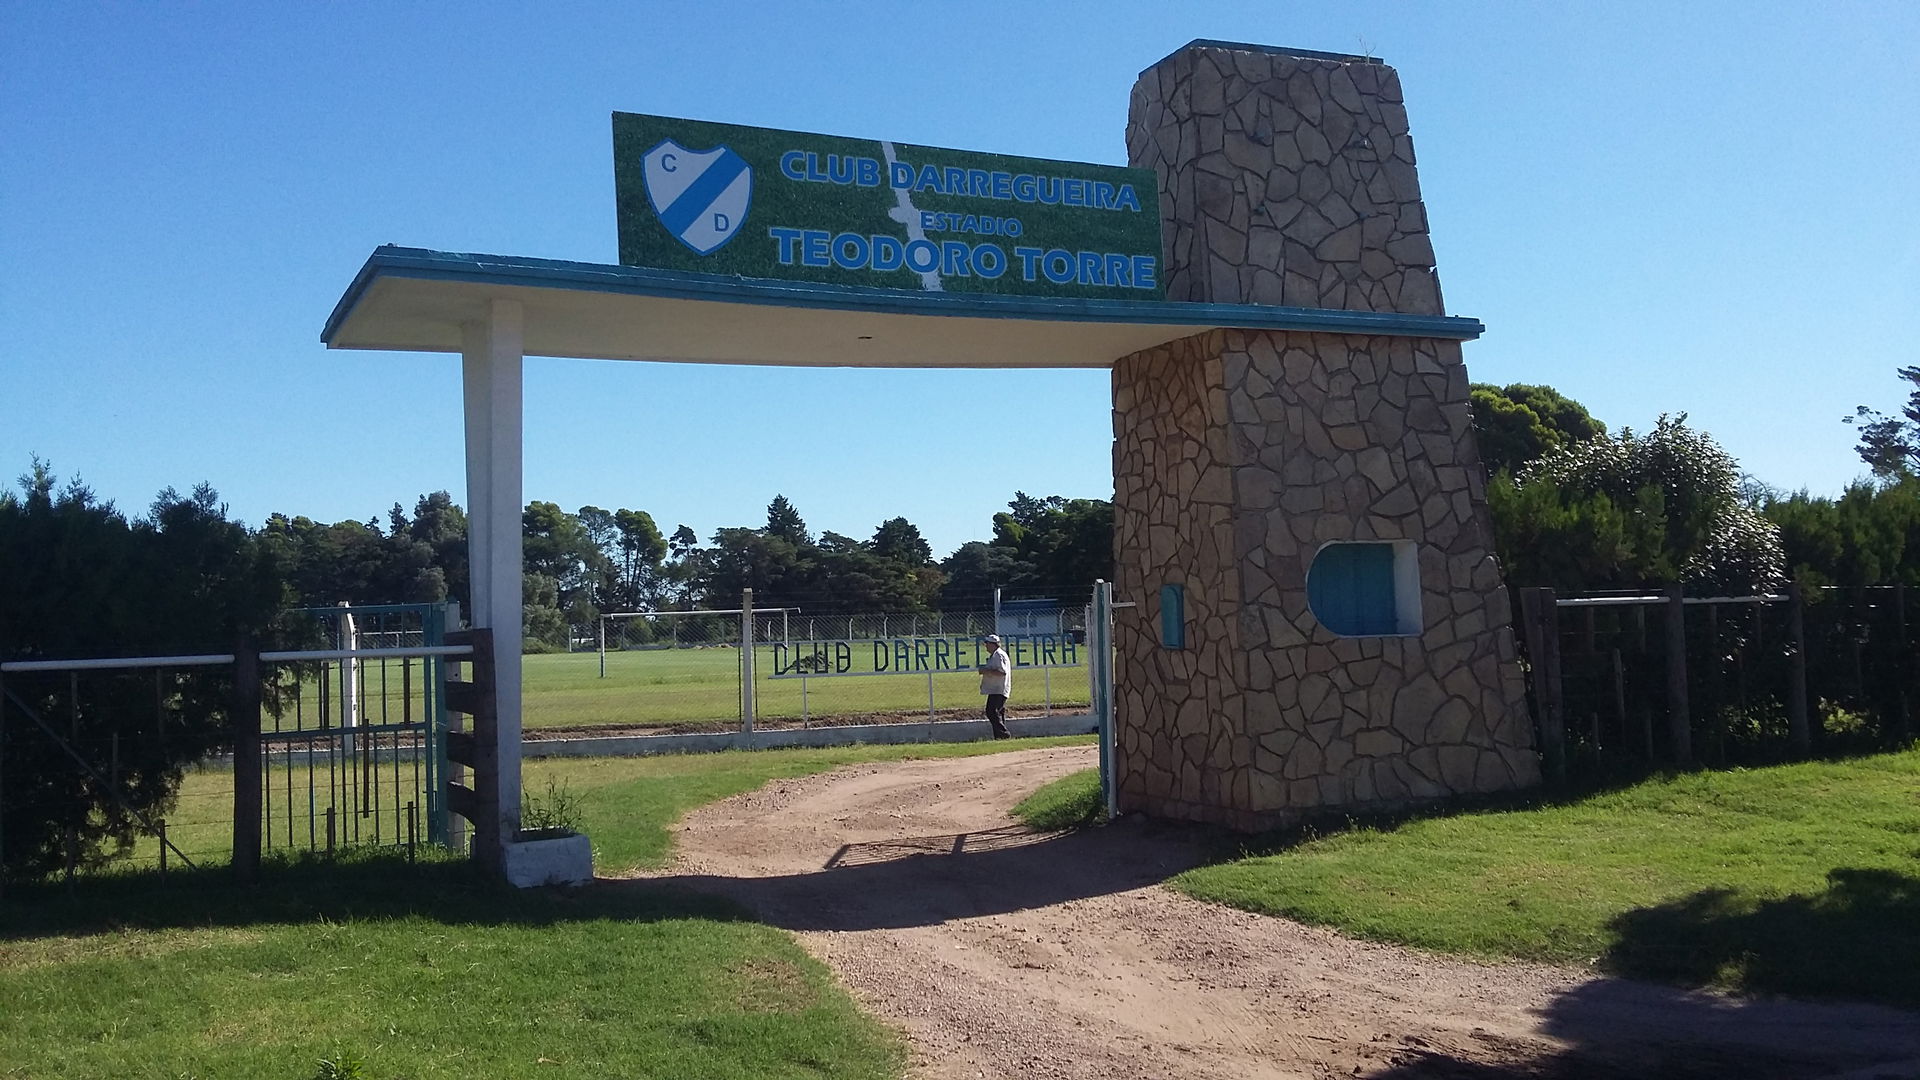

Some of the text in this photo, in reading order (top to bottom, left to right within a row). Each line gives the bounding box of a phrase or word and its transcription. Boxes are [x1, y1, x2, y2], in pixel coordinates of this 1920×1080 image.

[661, 153, 677, 172] C
[780, 150, 1141, 212] CLUB DARREGUEIRA
[714, 213, 730, 232] D
[920, 210, 1022, 238] ESTADIO
[769, 226, 1156, 289] TEODORO TORRE
